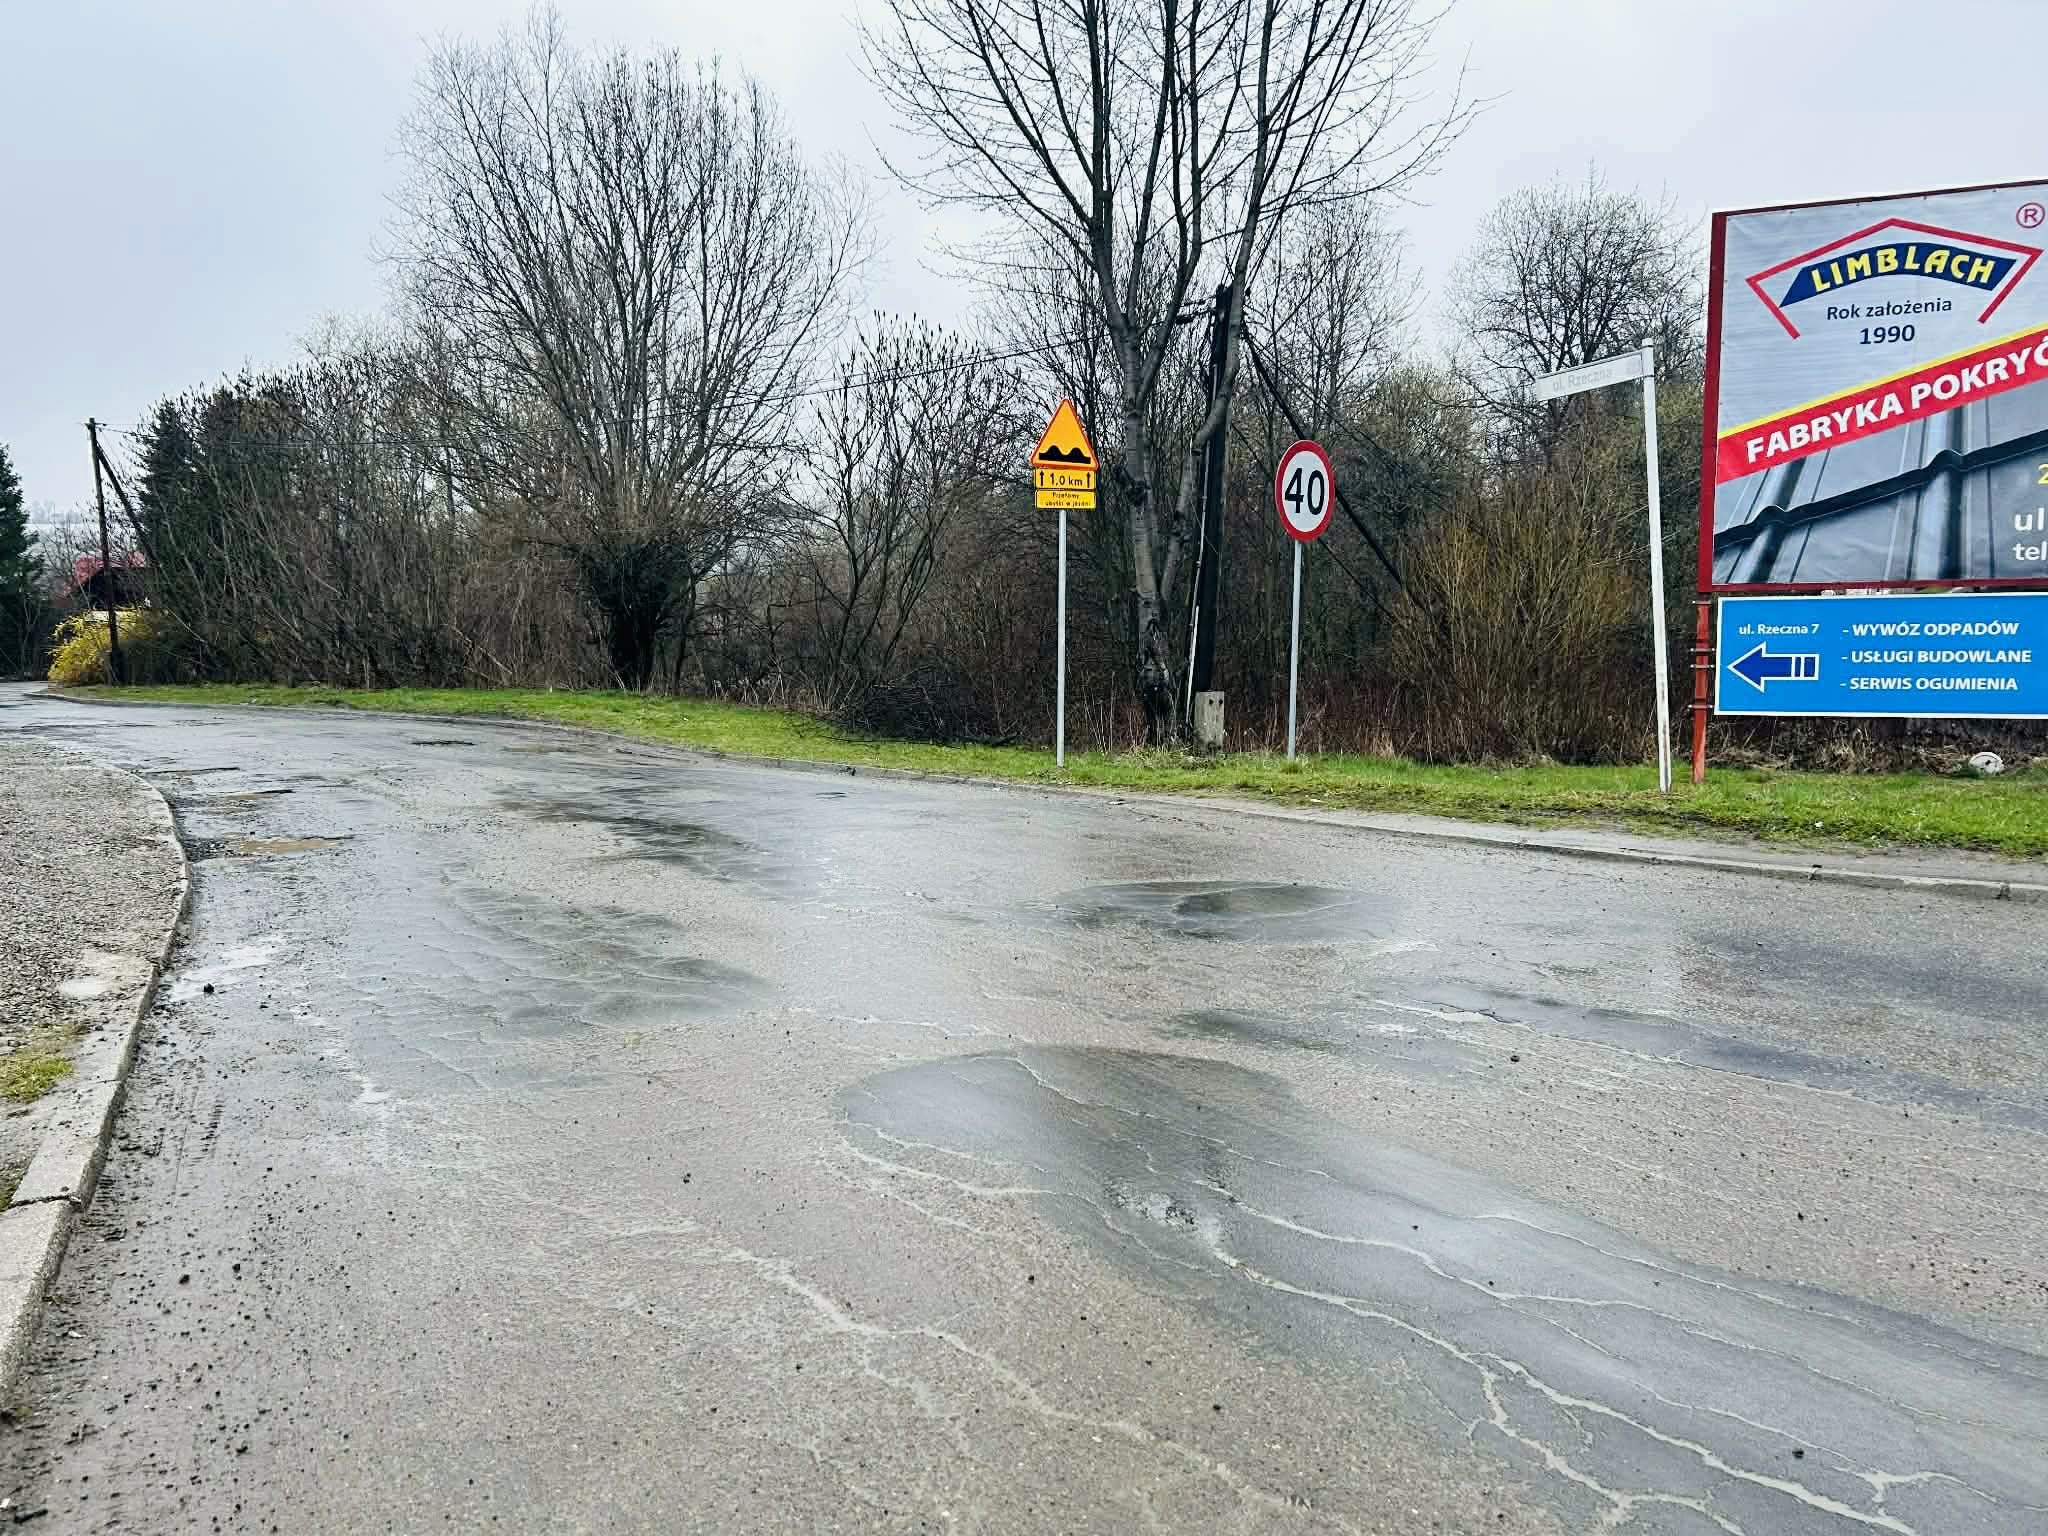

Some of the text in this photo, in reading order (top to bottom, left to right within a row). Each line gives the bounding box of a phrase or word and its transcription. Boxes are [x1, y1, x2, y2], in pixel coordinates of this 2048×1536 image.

[1811, 246, 1995, 293] LIMBLACH
[1826, 298, 1952, 321] Rok założenia
[1859, 324, 1916, 345] 1990
[1745, 391, 1905, 464] FABRYKA
[1068, 474, 1083, 486] km
[1284, 467, 1325, 515] 40
[1738, 623, 1820, 635] ul. Rzeczna 7
[1852, 620, 1921, 636] WYWÓZ
[1923, 620, 2020, 635] ODPADÓW
[1851, 650, 1914, 664] USŁUGI
[1917, 649, 2032, 664] BUDOWLANE
[1850, 677, 1913, 691] SERWIS
[1915, 677, 2018, 691] OGUMIENIA
